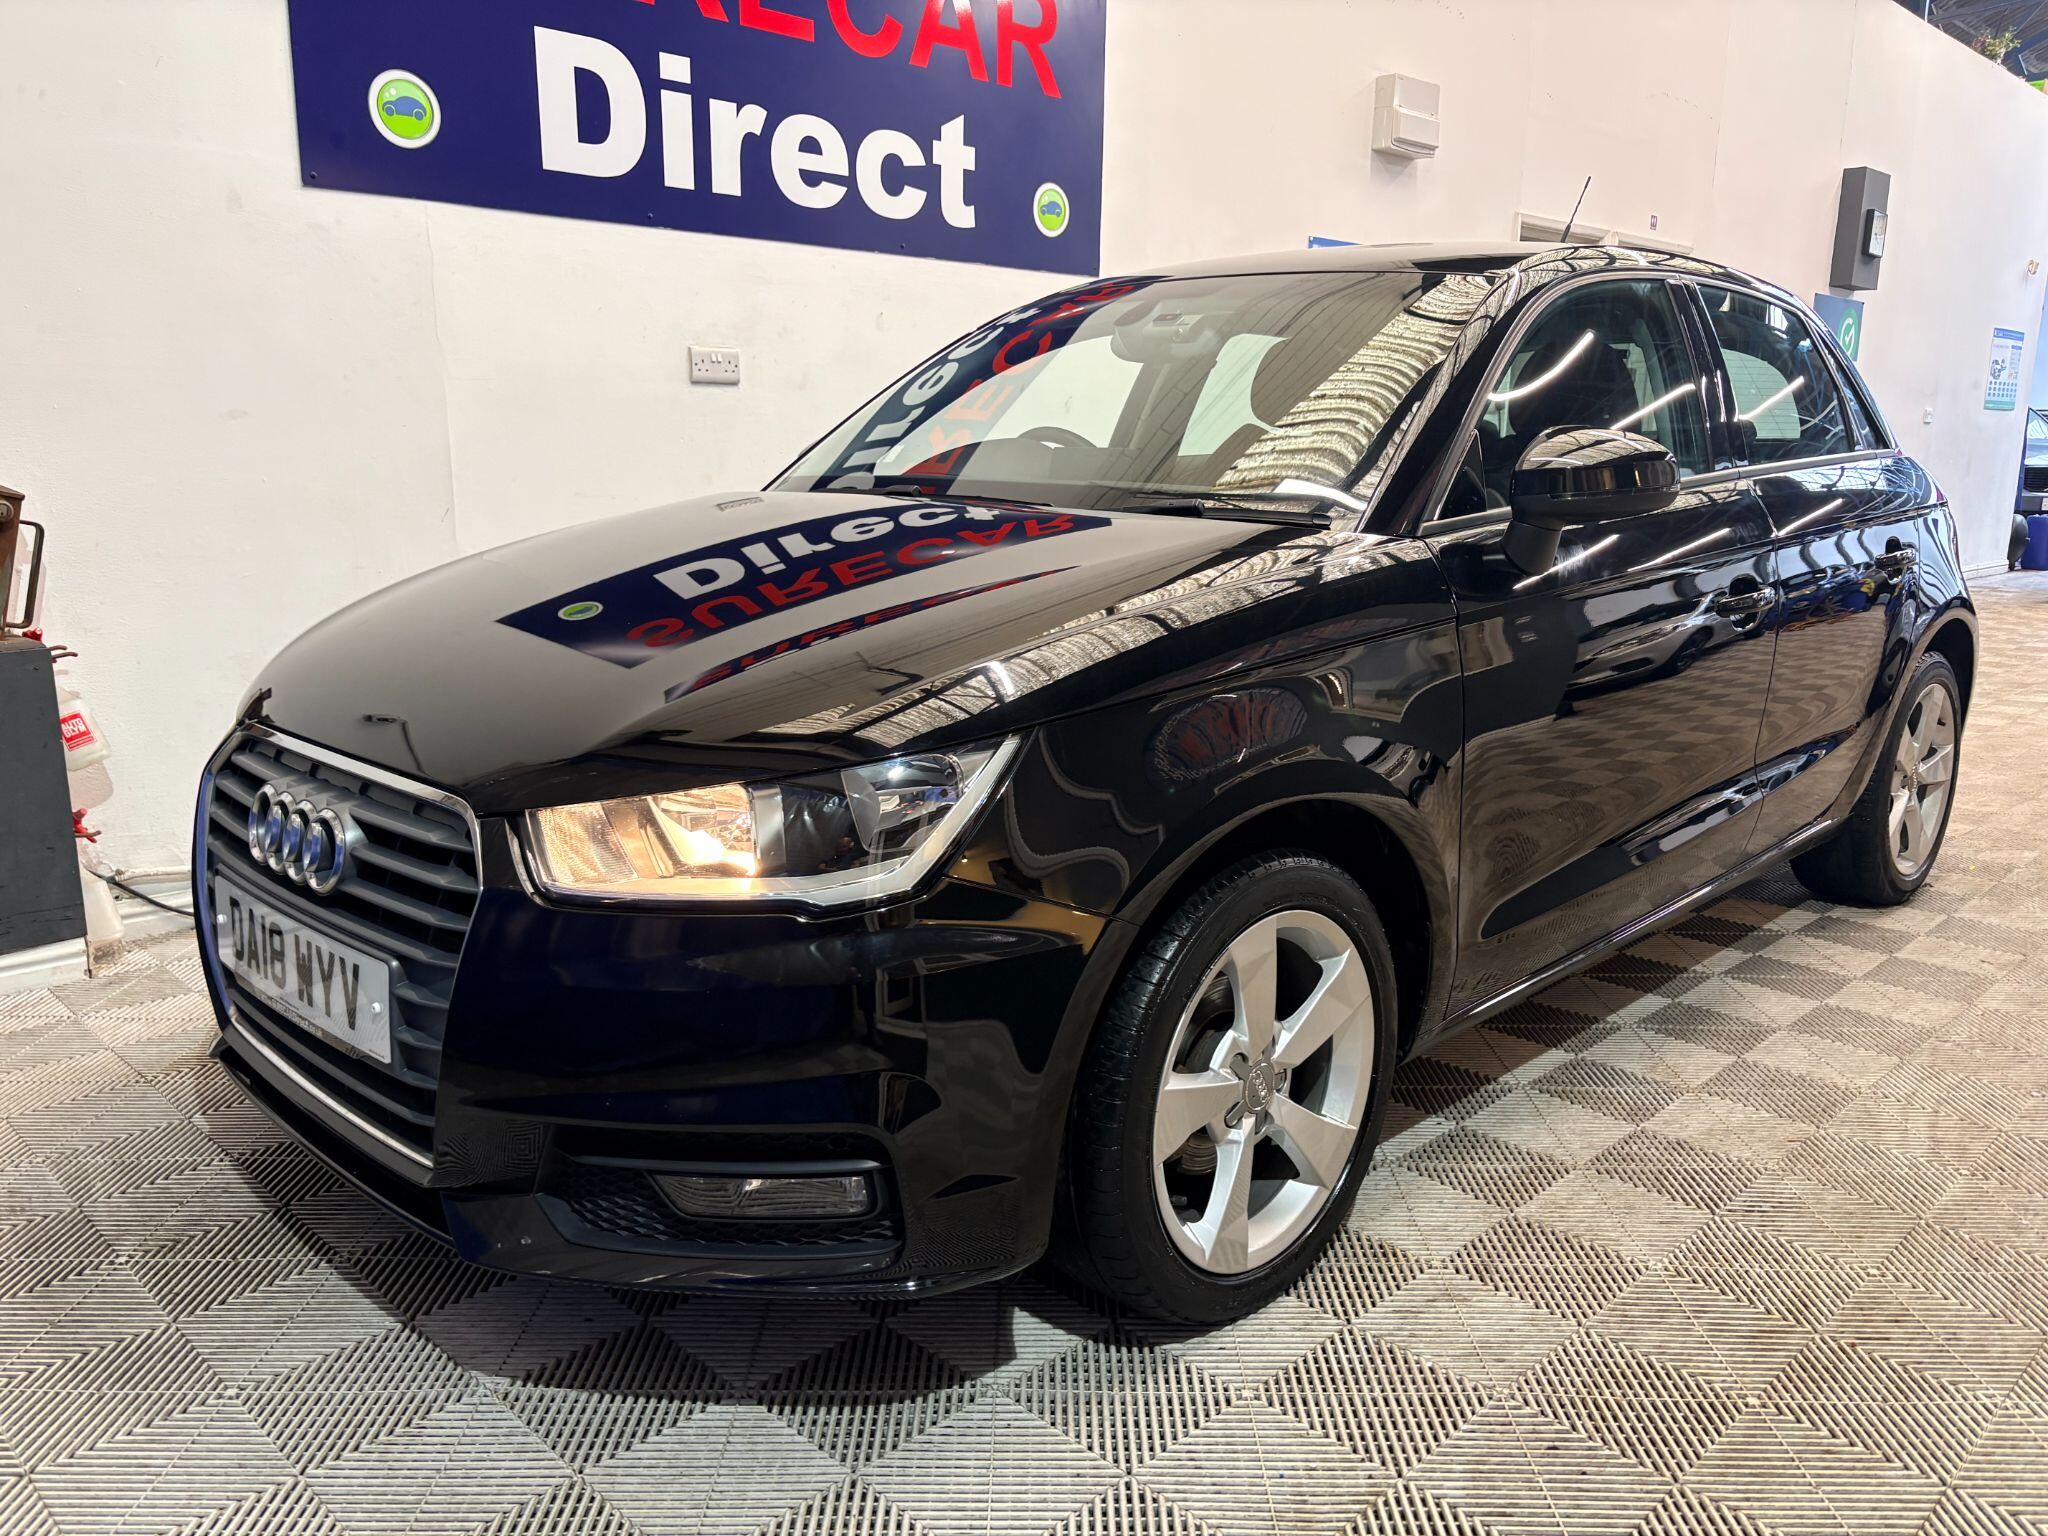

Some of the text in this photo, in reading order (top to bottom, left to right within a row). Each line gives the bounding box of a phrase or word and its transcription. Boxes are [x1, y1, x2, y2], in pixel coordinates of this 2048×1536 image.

[534, 26, 976, 229] Direct
[230, 896, 287, 989] DA18
[295, 933, 359, 1030] WYV
